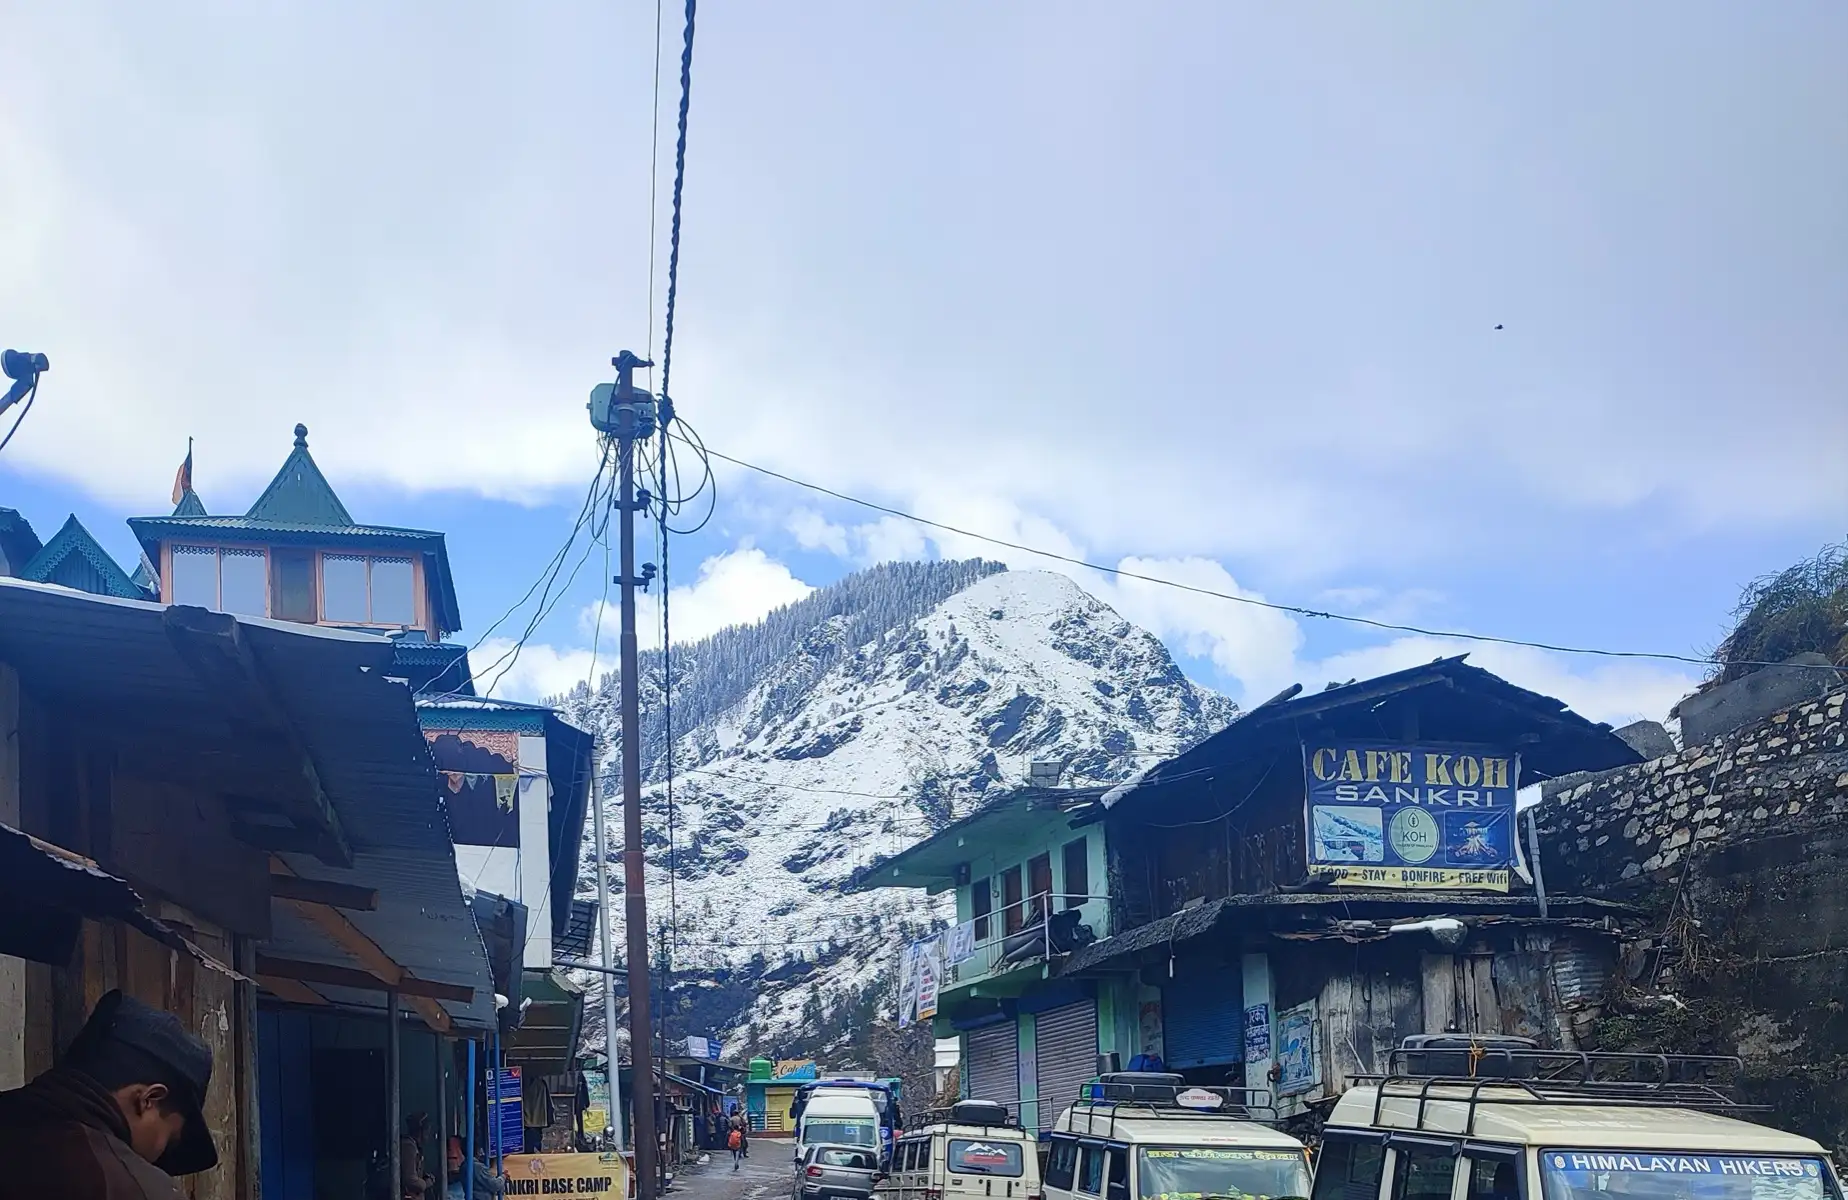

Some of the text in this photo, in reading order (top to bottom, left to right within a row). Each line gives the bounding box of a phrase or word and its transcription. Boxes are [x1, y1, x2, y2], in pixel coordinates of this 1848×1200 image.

[1312, 748, 1509, 789] CAFE KOH
[1335, 784, 1493, 807] SANKRI
[1402, 831, 1427, 842] KOH
[1361, 869, 1387, 881] STAY
[1401, 870, 1446, 883] BONFIRE
[1458, 872, 1484, 884] FREE
[1486, 872, 1507, 885] Wifi
[1571, 1155, 1805, 1177] HIMALAYAN HIKERS
[503, 1176, 612, 1196] ANKRI BASE CAMP
